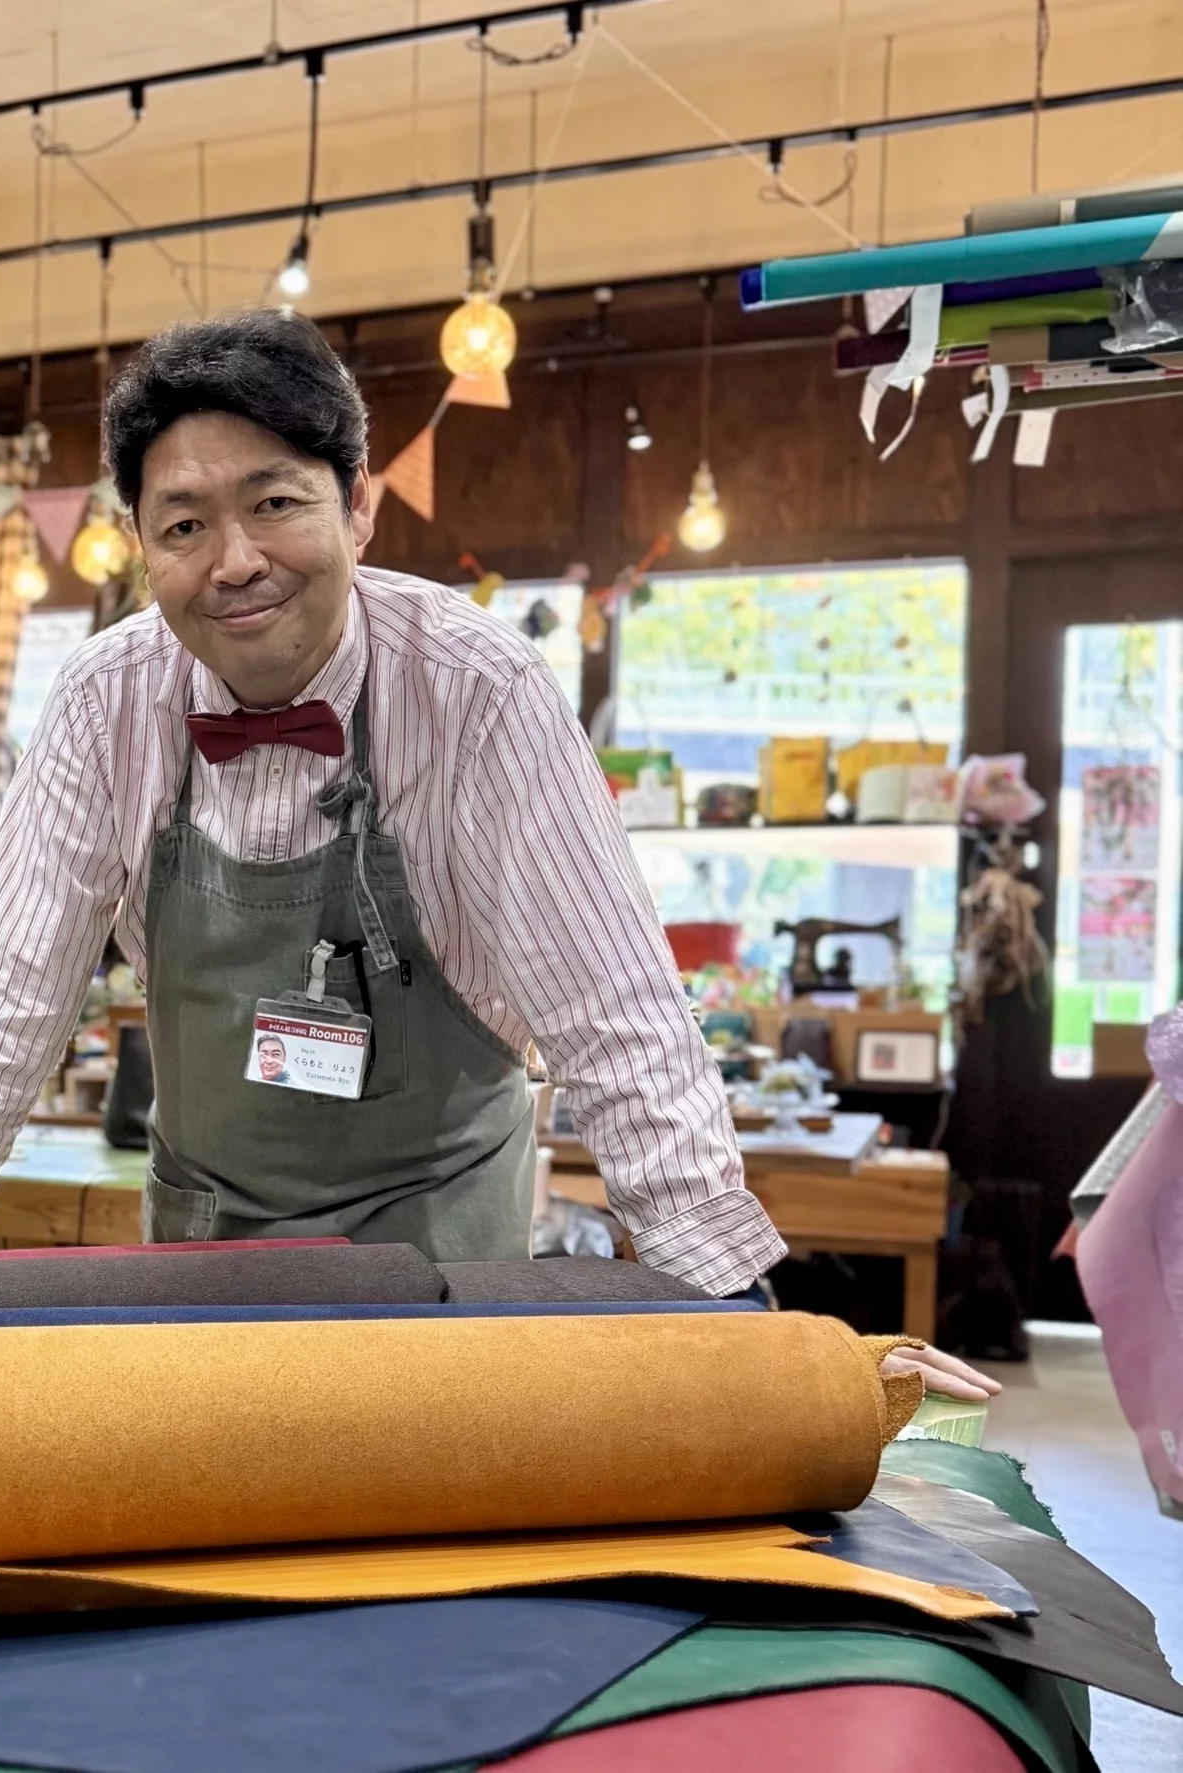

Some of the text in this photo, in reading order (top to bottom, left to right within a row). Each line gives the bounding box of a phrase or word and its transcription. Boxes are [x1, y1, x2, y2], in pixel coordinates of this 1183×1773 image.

[309, 1027, 364, 1045] Room106
[294, 1057, 324, 1069] くらもと
